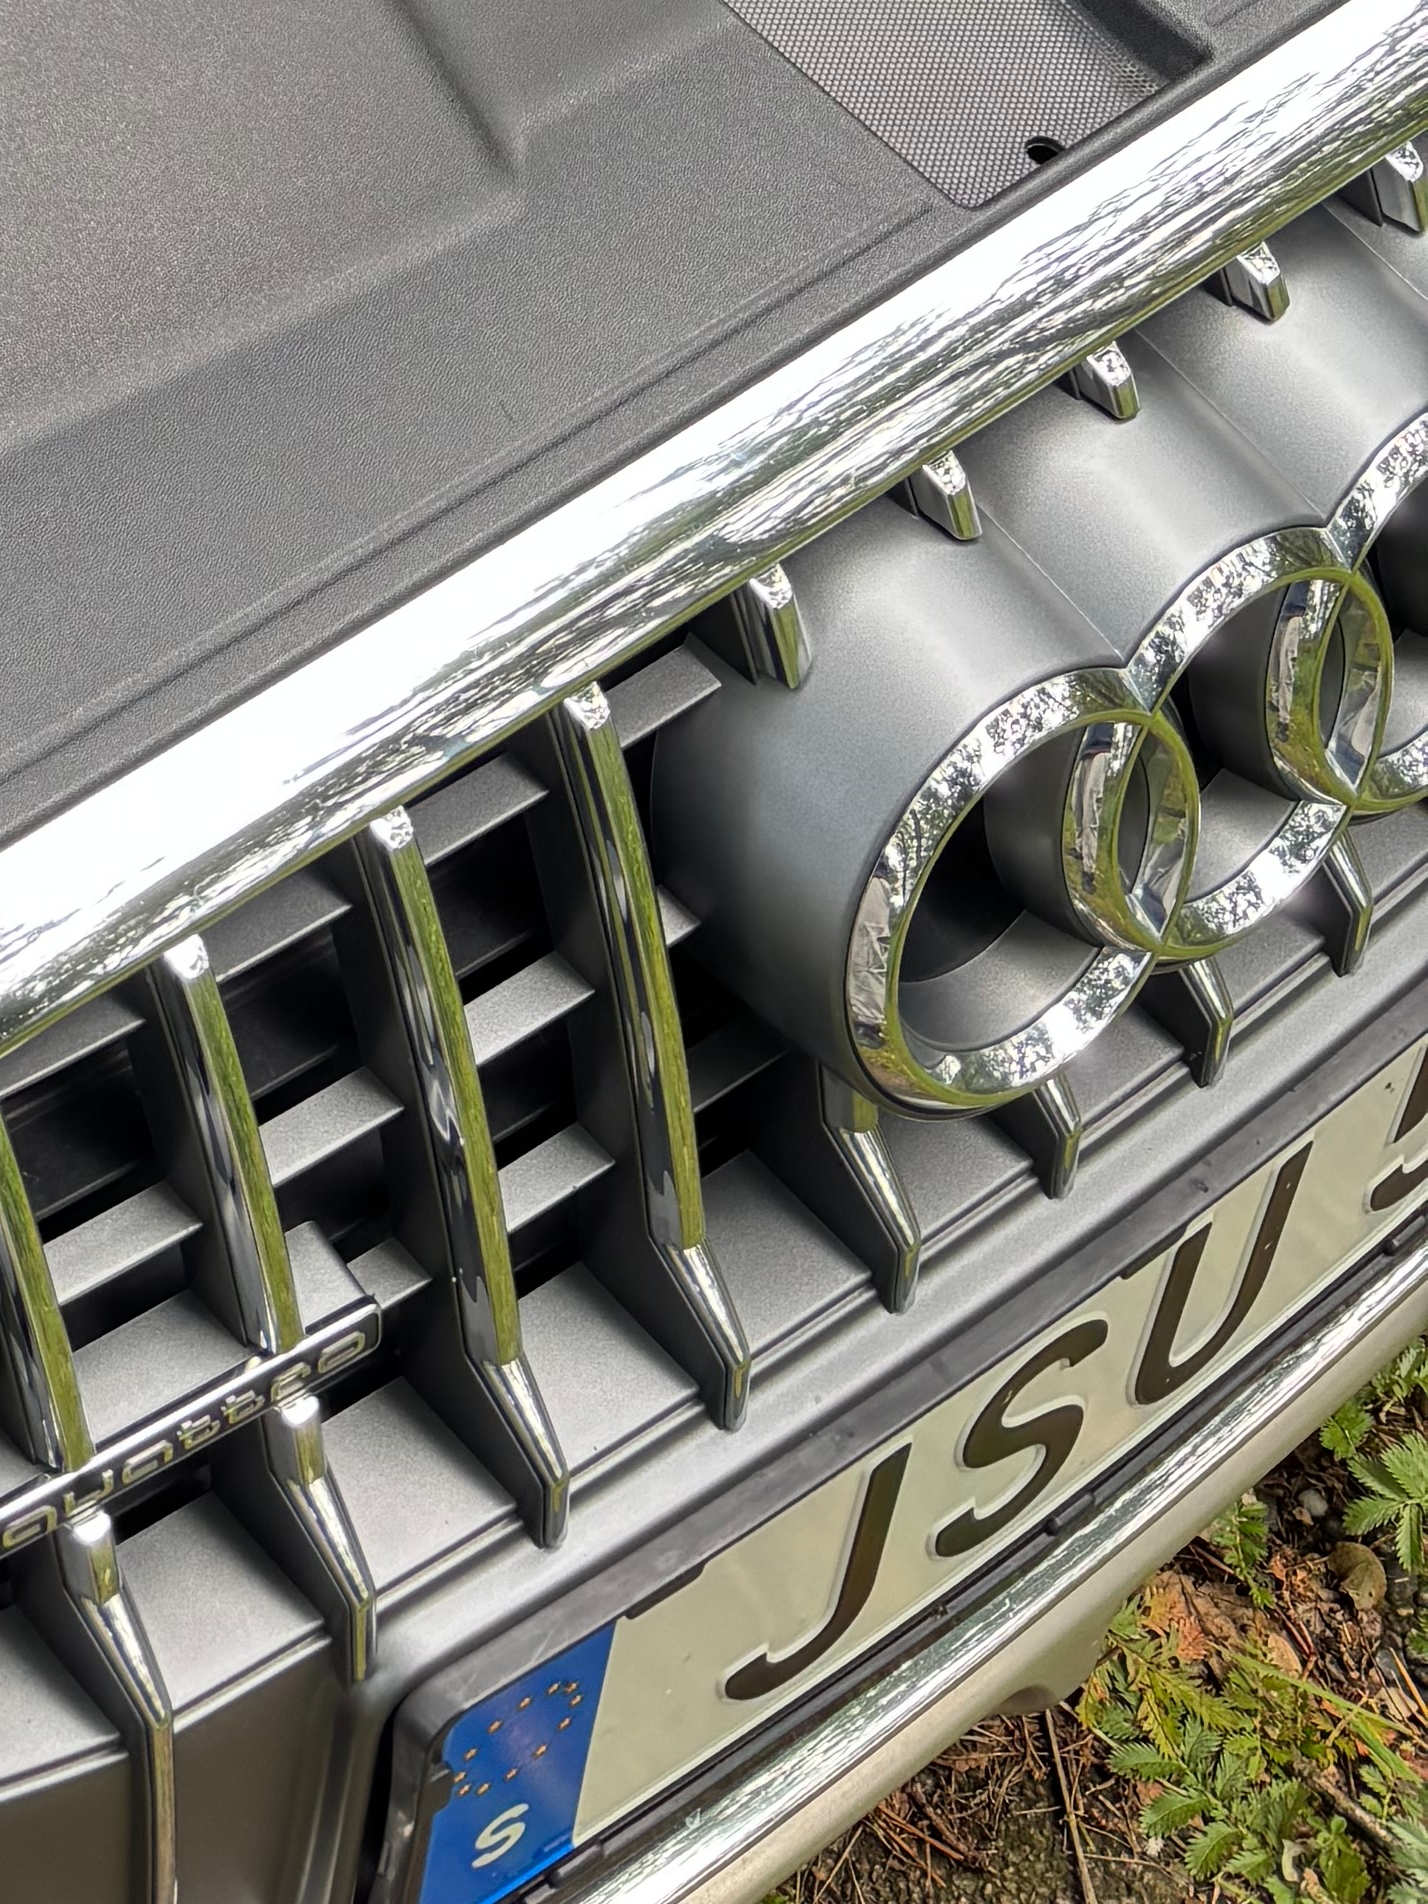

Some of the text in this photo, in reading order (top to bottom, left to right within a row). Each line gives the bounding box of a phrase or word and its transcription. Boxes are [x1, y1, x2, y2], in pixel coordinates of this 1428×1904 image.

[2, 1330, 366, 1552] quattro
[724, 1141, 1314, 1702] JSU
[470, 1802, 525, 1868] S
